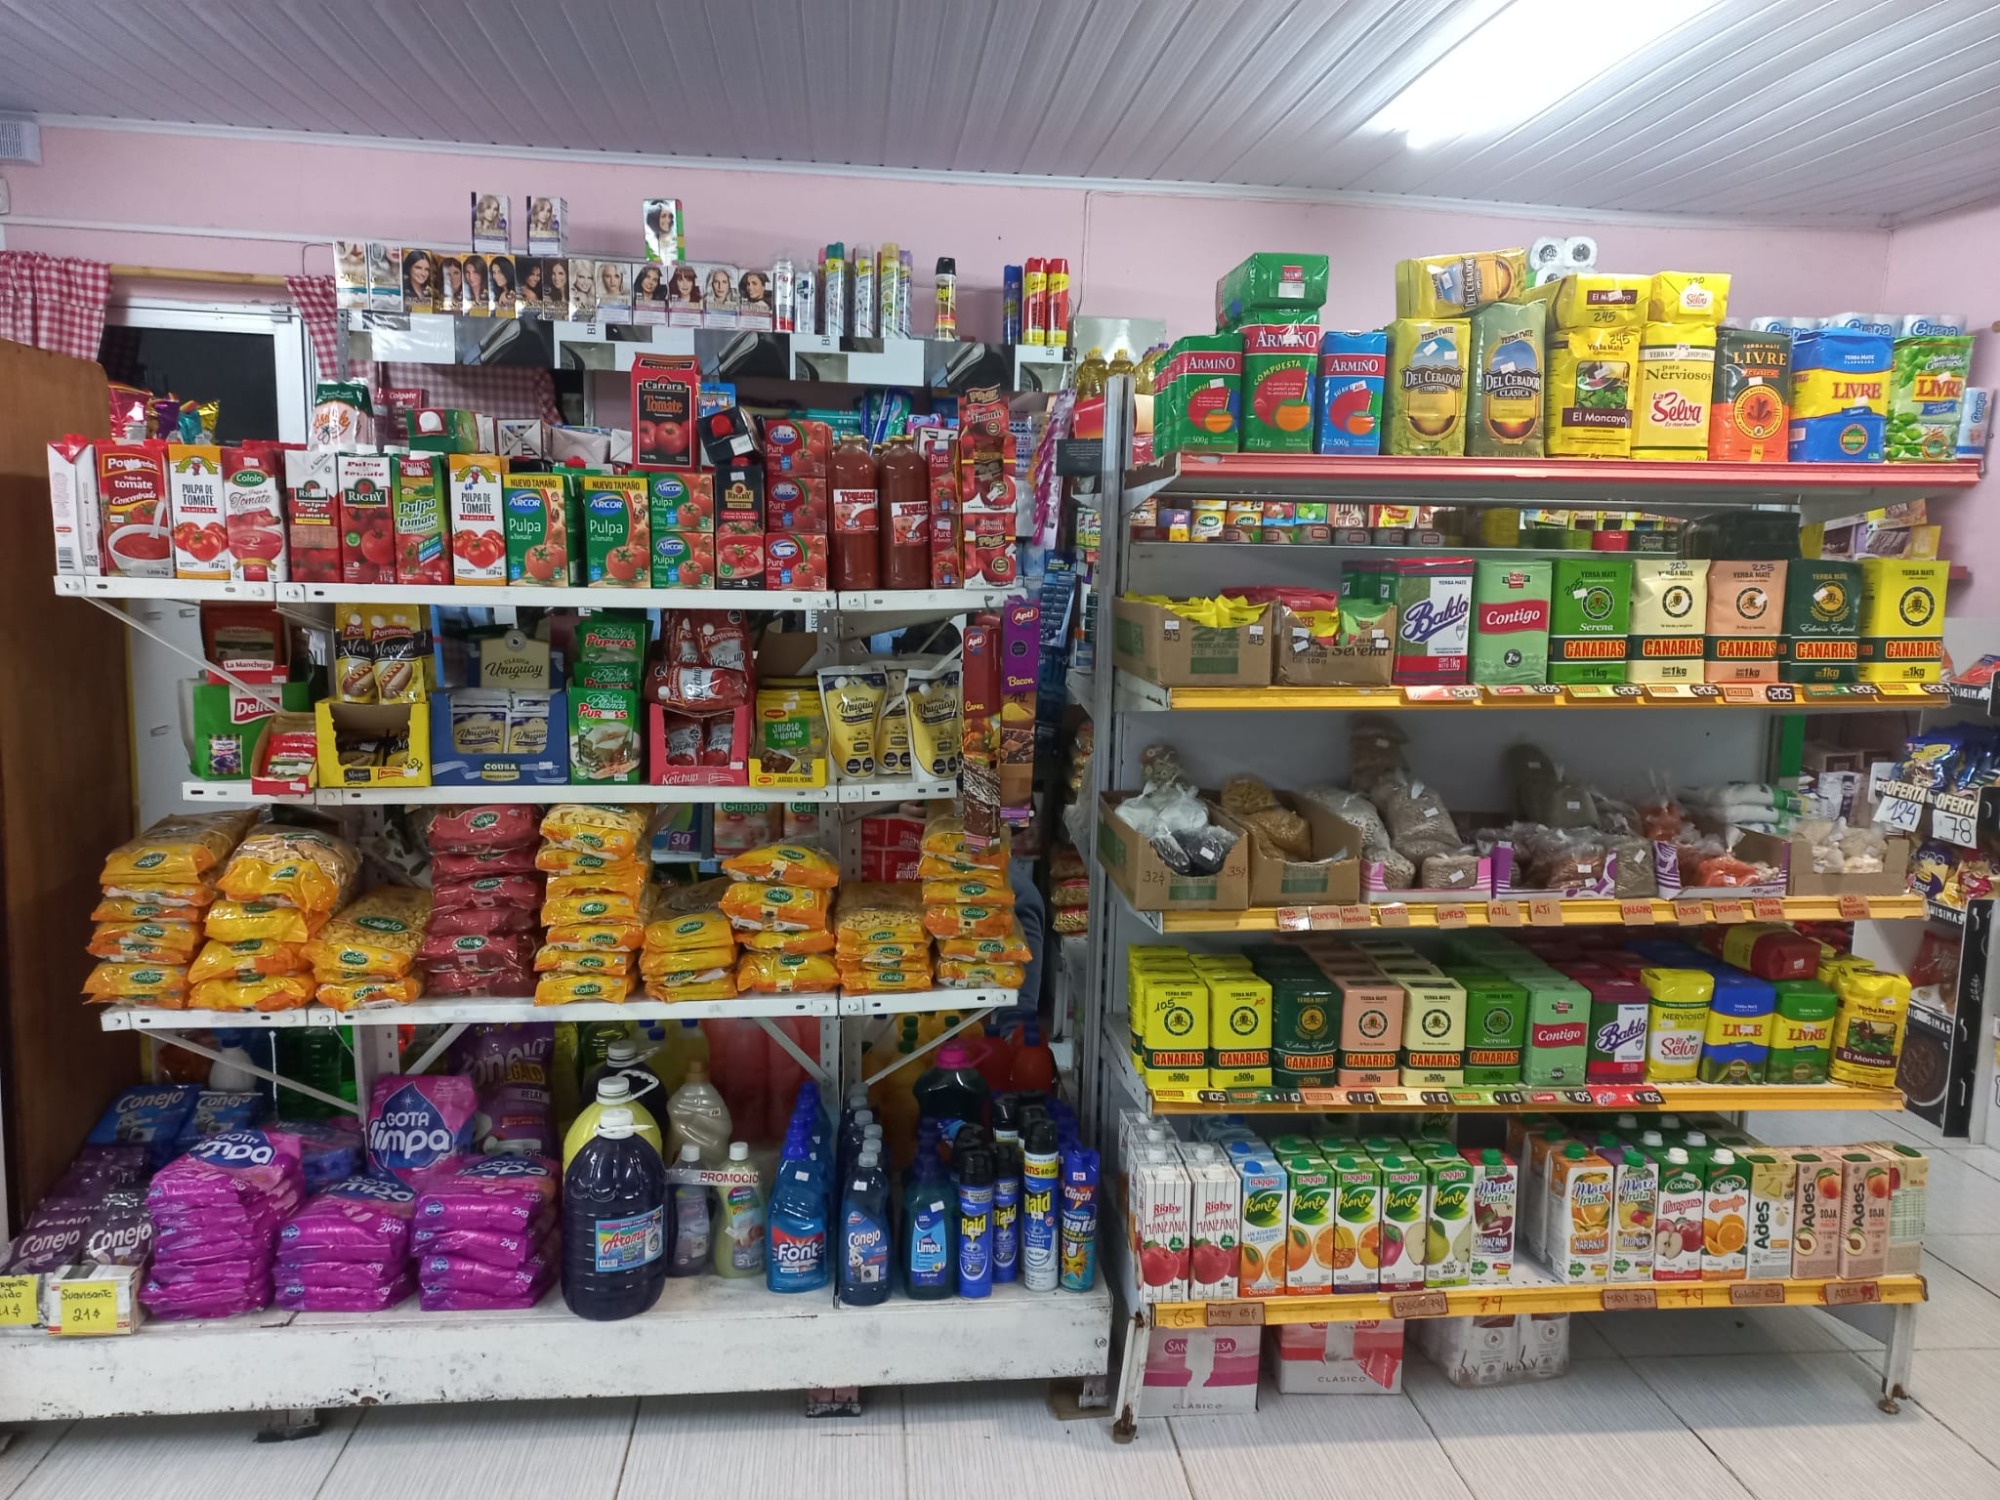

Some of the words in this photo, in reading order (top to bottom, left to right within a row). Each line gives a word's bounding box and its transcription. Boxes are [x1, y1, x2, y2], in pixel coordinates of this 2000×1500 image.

[1593, 311, 1616, 323] 245
[1846, 320, 1891, 336] Guapa
[1913, 321, 1957, 336] Guapa
[1609, 334, 1630, 345] 245
[1188, 356, 1236, 370] ARMIÑO
[1330, 358, 1378, 372] ARMIÑO
[1733, 352, 1787, 366] LIVRE
[1253, 360, 1301, 386] COMPUESTA
[1645, 368, 1711, 382] Nerviosos
[1662, 364, 1680, 373] para
[1405, 371, 1423, 385] DEL
[1425, 371, 1461, 386] CEBADOR
[1486, 375, 1504, 389] DEL
[1504, 375, 1541, 391] CEBADOR
[645, 381, 683, 391] Carrara
[1832, 382, 1882, 399] LIVRE
[644, 394, 683, 413] Tomate
[1652, 392, 1702, 423] Selva
[1573, 412, 1583, 422] El
[1588, 412, 1627, 424] Moncayo
[767, 444, 784, 453] Puré
[931, 453, 948, 463] Puré
[115, 480, 152, 489] tomate
[236, 472, 262, 483] Cololo
[510, 478, 529, 487] NUEVO
[530, 478, 557, 488] TAMAÑO
[182, 484, 204, 494] PULPA
[205, 484, 213, 494] DE
[592, 481, 611, 489] NUEVO
[612, 480, 640, 491] TAMAÑO
[655, 483, 683, 493] ARCOR
[183, 494, 214, 506] TOMATE
[348, 491, 383, 502] RIGBY
[461, 493, 479, 503] PULPA
[482, 494, 491, 503] DE
[509, 496, 541, 508] ARCOR
[590, 498, 623, 509] ARCOR
[651, 497, 673, 507] Pulpa
[400, 498, 435, 514] Pulpa
[462, 503, 492, 514] TOMATE
[768, 500, 785, 510] Puré
[400, 514, 437, 527] Tomate
[509, 519, 541, 533] Pulpa
[590, 520, 623, 535] Pulpa
[934, 528, 951, 538] Puré
[656, 541, 685, 551] ARCOR
[653, 555, 675, 565] Pulpa
[767, 558, 784, 567] Puré
[1902, 569, 1919, 577] YERBA
[1920, 569, 1935, 577] MATE
[1401, 594, 1469, 643] Baldo
[1486, 609, 1540, 626] Contigo
[1579, 623, 1614, 632] Serena
[1565, 640, 1626, 658] CANARIAS
[1642, 639, 1704, 656] CANARIAS
[1717, 639, 1777, 657] CANARIAS
[1796, 641, 1857, 660] CANARIAS
[1886, 638, 1941, 657] CANARIAS
[235, 661, 272, 670] Manchega
[485, 662, 543, 678] Uruguay
[1671, 666, 1688, 678] 1kg
[1909, 666, 1925, 679] 1kg
[1591, 668, 1607, 679] 1kg
[1744, 667, 1760, 679] 1kg
[1821, 667, 1840, 679] 1kg
[1008, 676, 1035, 687] Bacon
[917, 700, 955, 714] Uruguay
[662, 773, 699, 785] Ketchup
[1887, 780, 1926, 802] OFERTA
[1936, 794, 1977, 817] OFERTA
[671, 833, 690, 846] 30
[1154, 999, 1175, 1012] 105
[1662, 1012, 1706, 1021] NERVIOSOS
[1538, 1029, 1581, 1042] Contigo
[1595, 1019, 1647, 1053] Baldo
[1788, 1028, 1827, 1040] LIVRE
[1661, 1037, 1698, 1056] Selva
[1153, 1052, 1204, 1066] CANARIAS
[1219, 1052, 1269, 1066] CANARIAS
[1285, 1055, 1334, 1069] CANARIAS
[1346, 1053, 1396, 1067] CANARIAS
[1409, 1053, 1460, 1068] CANARIAS
[1470, 1051, 1519, 1064] CANARIAS
[116, 1090, 185, 1114] Conejo
[197, 1095, 252, 1109] Conejo
[386, 1112, 429, 1127] GOTA
[370, 1121, 452, 1158] limpa
[1297, 1175, 1326, 1185] Baggio
[1343, 1173, 1372, 1182] Baggio
[1390, 1173, 1420, 1182] Baggio
[1439, 1170, 1466, 1179] Baggio
[1249, 1177, 1278, 1187] Baggio
[1670, 1180, 1695, 1190] Cololo
[1064, 1186, 1092, 1201] Clinch
[1338, 1192, 1372, 1209] Pronto
[1434, 1191, 1465, 1207] Pronto
[1579, 1193, 1605, 1206] fruta
[1625, 1192, 1650, 1203] fruta
[1024, 1191, 1051, 1213] Raid
[1244, 1196, 1279, 1214] Pronto
[1292, 1195, 1327, 1212] Pronto
[1385, 1192, 1419, 1210] Pronto
[1802, 1183, 1816, 1227] Ades
[1852, 1183, 1866, 1227] Ades
[511, 1207, 529, 1218] 2kg
[1153, 1203, 1182, 1217] Rigby
[1205, 1201, 1233, 1216] Rigby
[1820, 1209, 1837, 1220] SOJA
[1869, 1208, 1885, 1219] SOJA
[961, 1215, 986, 1236] Raid
[1145, 1221, 1187, 1235] MANZANA
[1196, 1218, 1239, 1233] MANZANA
[1754, 1201, 1770, 1249] Ades
[19, 1228, 81, 1258] Conejo
[88, 1223, 152, 1253] Conejo
[500, 1238, 518, 1250] 2kg
[603, 1230, 647, 1254] Aroma
[848, 1231, 881, 1248] Conejo
[777, 1241, 819, 1262] Font
[515, 1272, 533, 1283] 2kg
[1174, 1310, 1195, 1326] 65
